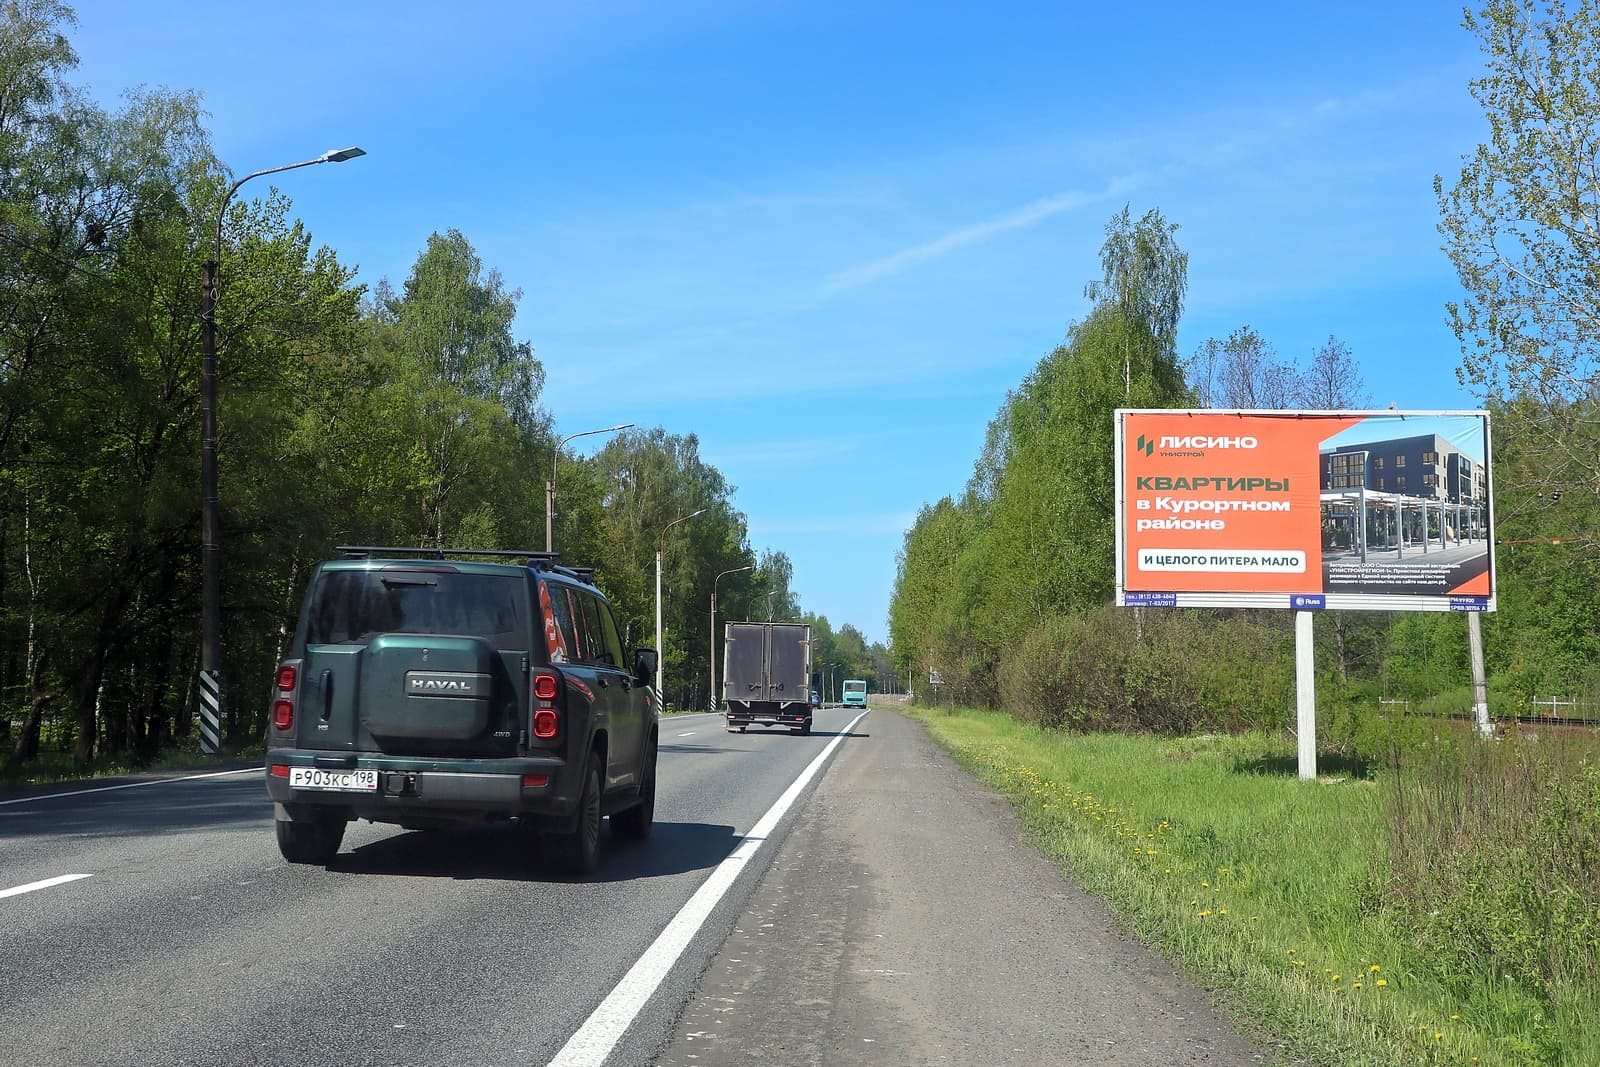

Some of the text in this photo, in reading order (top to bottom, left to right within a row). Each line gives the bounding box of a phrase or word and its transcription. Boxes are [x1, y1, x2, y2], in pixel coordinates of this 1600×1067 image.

[1159, 436, 1258, 449] ЛИСИНО
[1136, 477, 1290, 492] КВАРТИРЫ
[1136, 496, 1291, 514] в Курортном
[1136, 516, 1226, 532] районе
[1144, 555, 1300, 567] И ЦЕЛОГО ПИТЕРА МАЛО
[411, 679, 472, 690] HAVAL
[353, 771, 374, 784] 198
